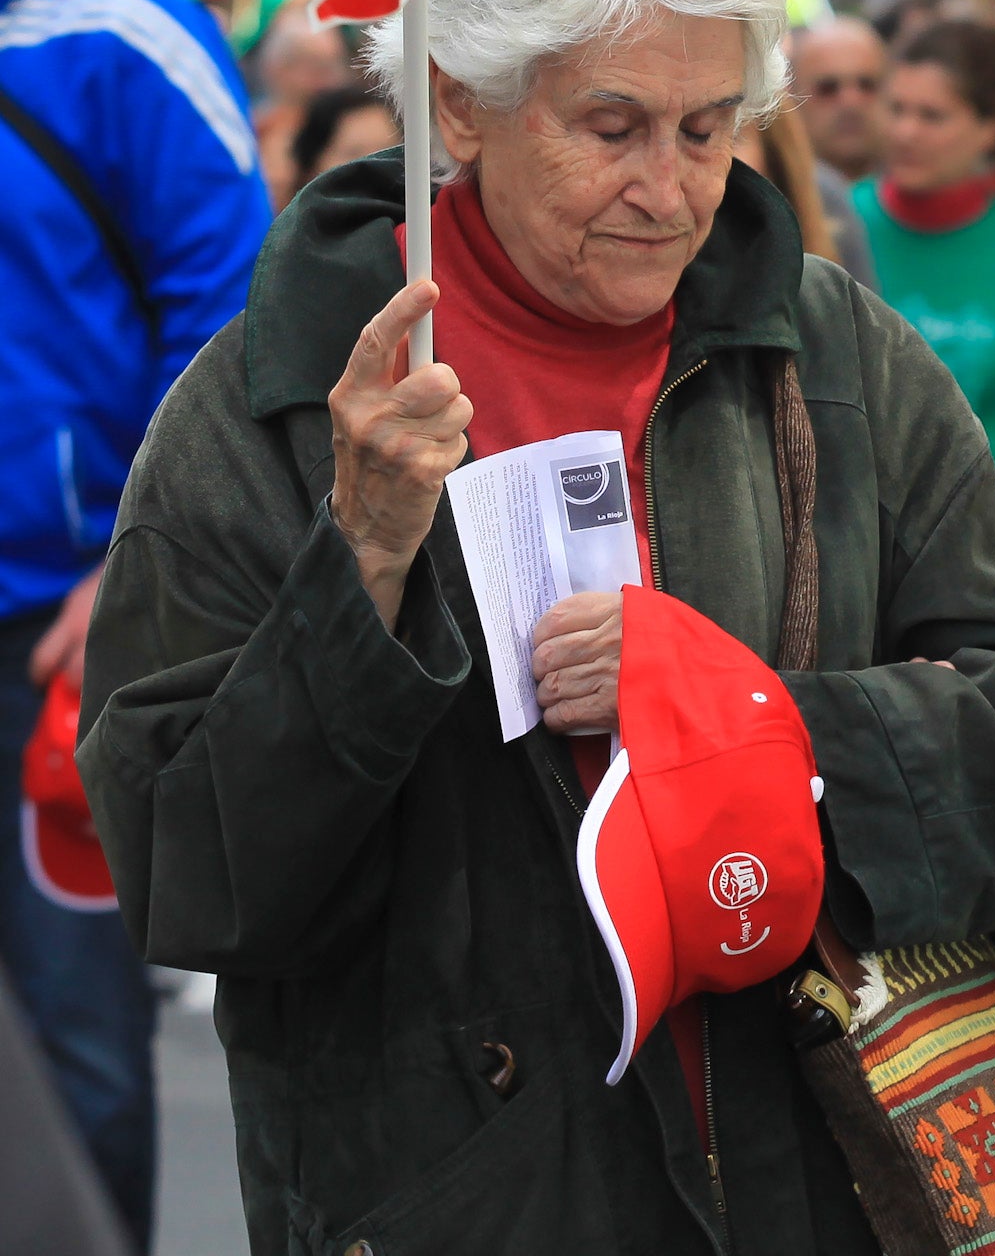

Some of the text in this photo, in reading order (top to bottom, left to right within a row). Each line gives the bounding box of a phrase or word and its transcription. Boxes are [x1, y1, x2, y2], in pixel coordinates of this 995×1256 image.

[562, 471, 602, 484] CÍRCULO
[606, 511, 624, 519] Rioja
[729, 860, 759, 900] UGT
[739, 908, 749, 921] La
